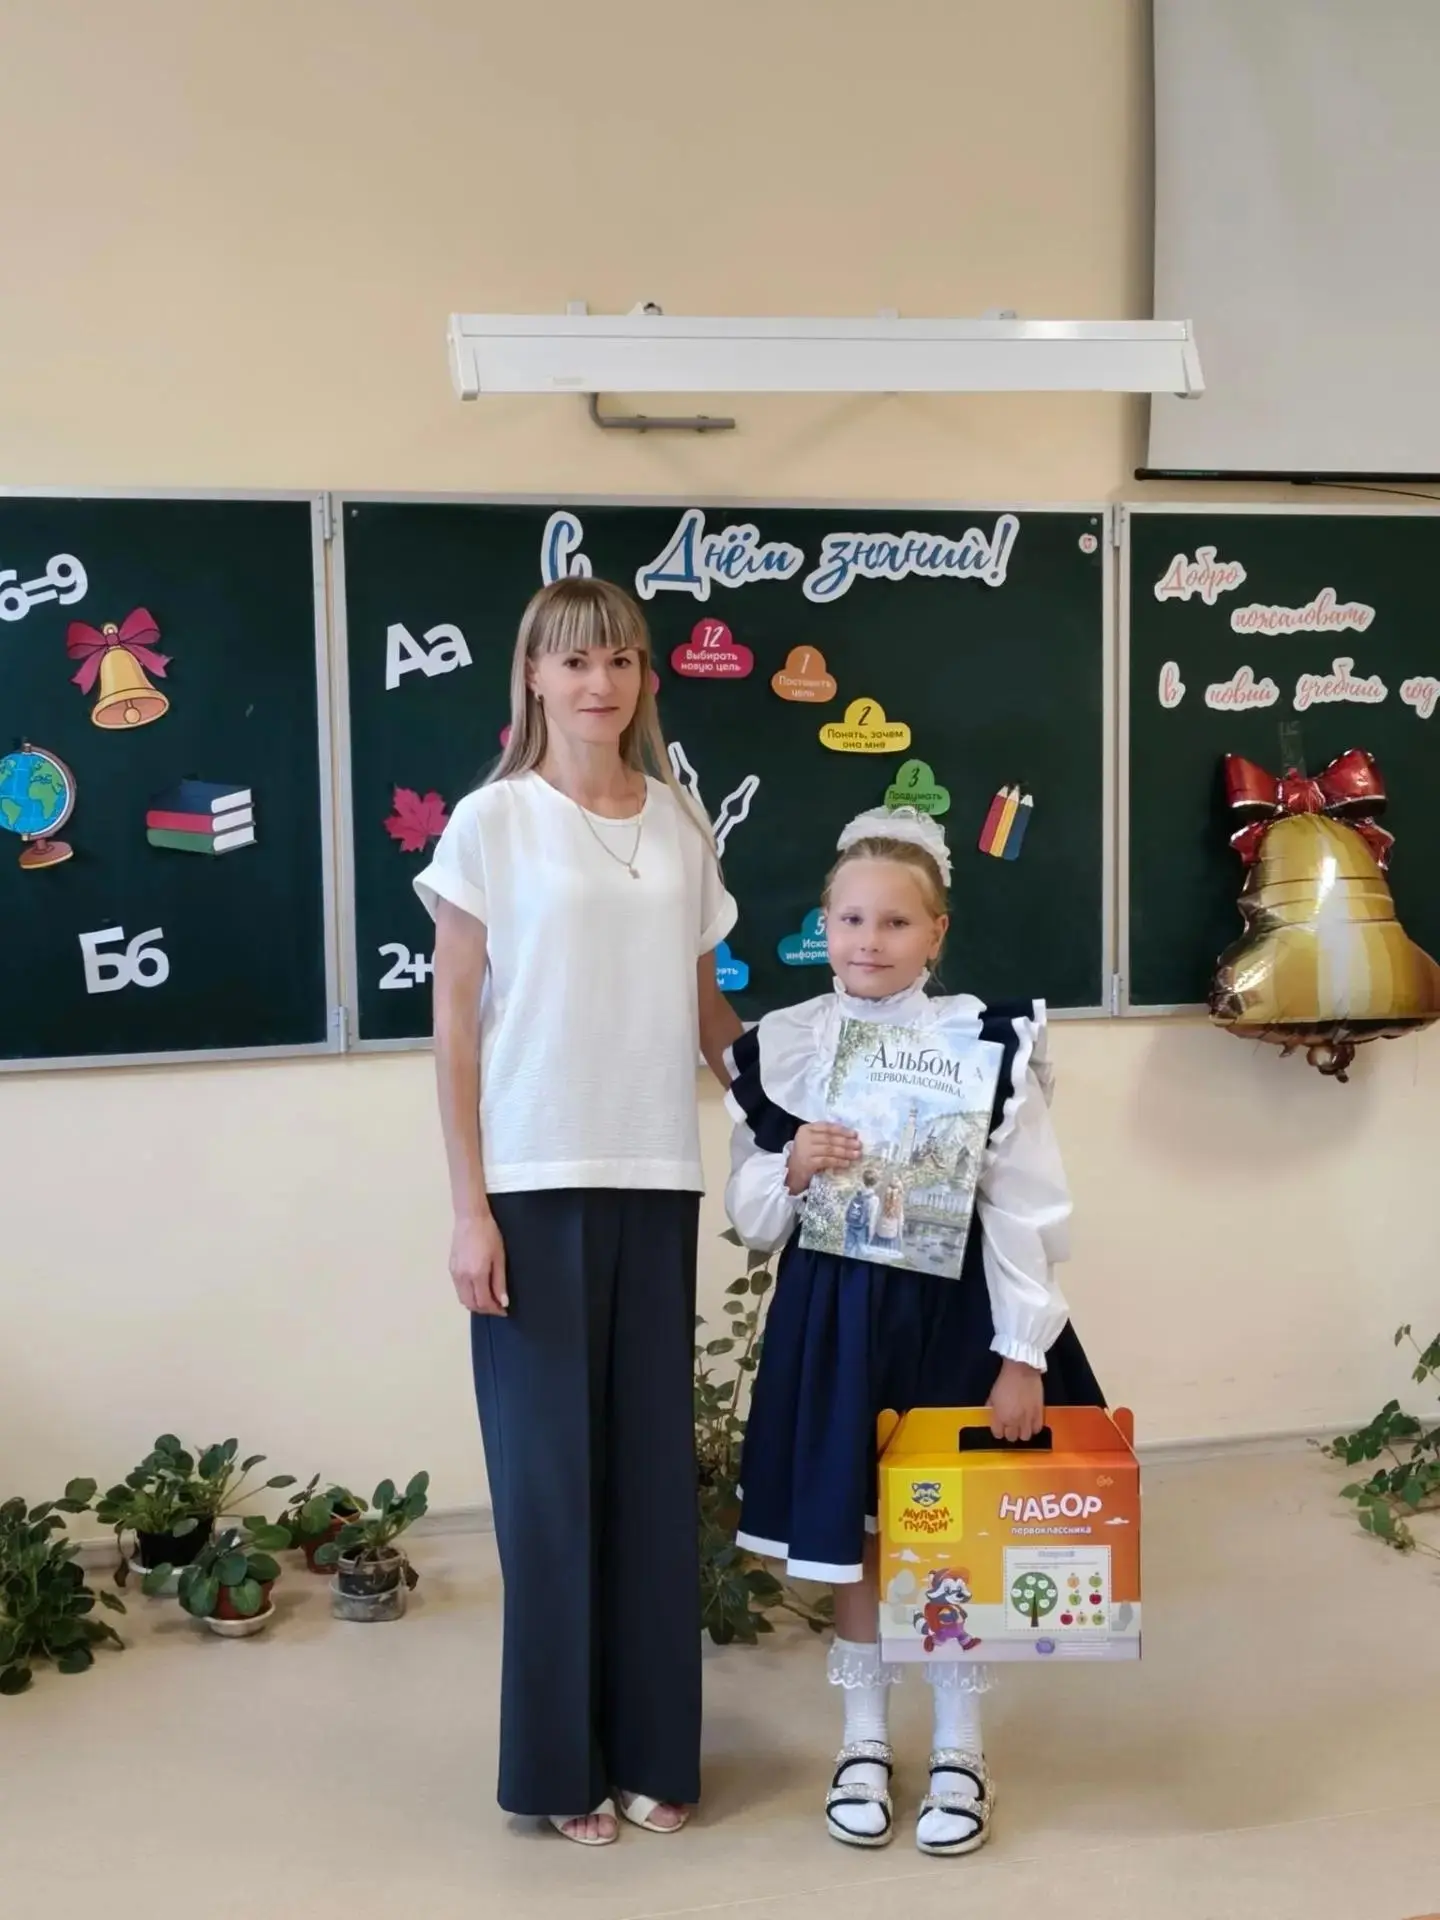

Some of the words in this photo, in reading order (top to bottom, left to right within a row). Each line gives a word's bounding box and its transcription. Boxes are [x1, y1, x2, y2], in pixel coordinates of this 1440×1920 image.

[643, 516, 797, 593] Днём
[810, 521, 1013, 595] знаний!
[1159, 550, 1240, 599] Добро
[1234, 592, 1371, 630] пожаловать
[703, 626, 724, 648] 12
[386, 622, 473, 690] Аа
[686, 650, 739, 662] Выбирать
[801, 653, 811, 674] 1
[681, 662, 714, 674] новую
[716, 662, 742, 672] цель
[858, 705, 872, 726] 2
[827, 728, 868, 740] Понять,
[871, 730, 904, 739] зачем
[908, 767, 920, 788] 3
[814, 915, 826, 936] 5
[79, 927, 170, 994] Бб
[869, 1071, 966, 1099] ПЕРВОКЛАССНИКА
[902, 1506, 950, 1521] МУЛЬТИ
[999, 1492, 1103, 1522] НАБОР
[904, 1519, 949, 1534] ПУЛЬТИ
[1011, 1526, 1092, 1537] первоклассника
